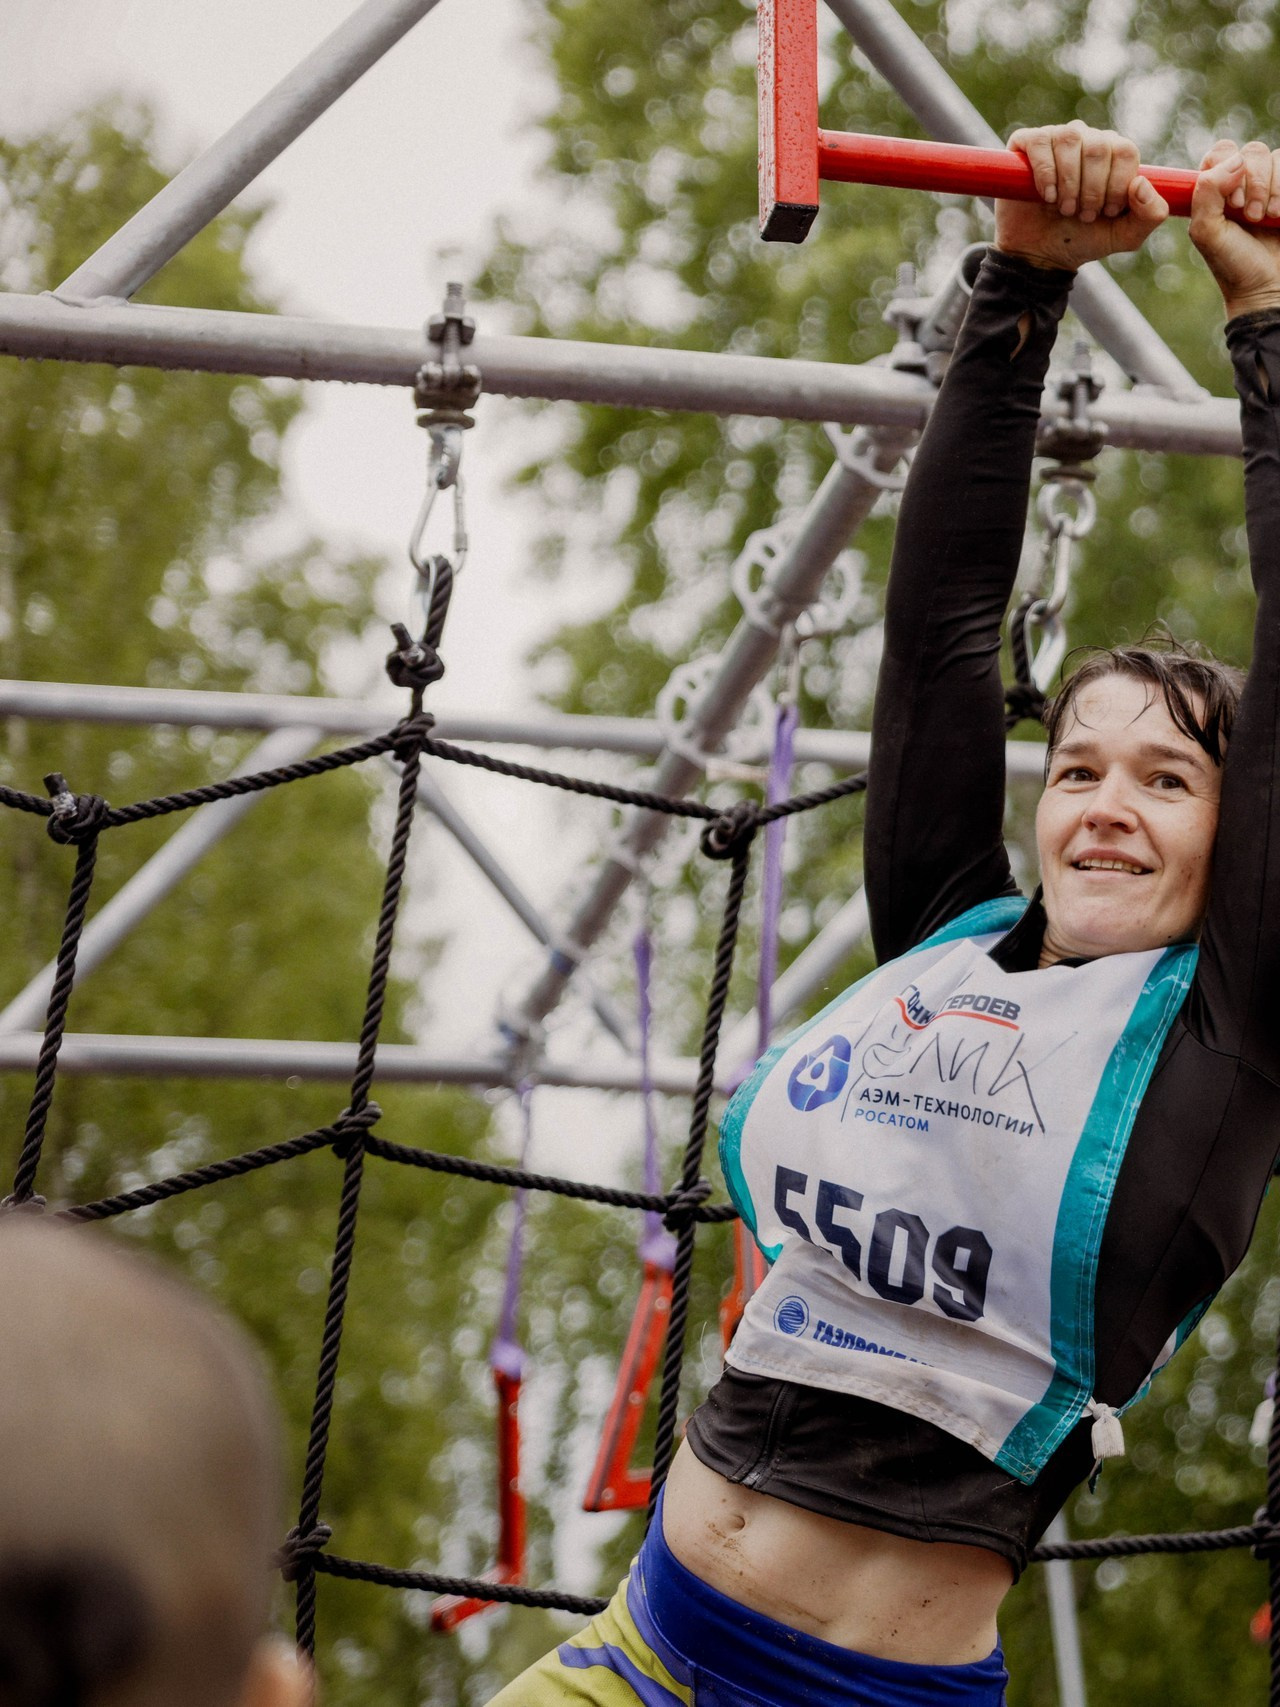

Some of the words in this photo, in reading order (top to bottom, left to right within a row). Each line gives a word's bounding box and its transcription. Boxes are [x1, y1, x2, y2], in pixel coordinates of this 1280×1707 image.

[940, 994, 1021, 1020] ГЕРОЕВ
[855, 1108, 929, 1132] РОСАТОМ
[859, 1087, 1034, 1137] АЭМ-ТЕХНОЛОГИИ
[774, 1165, 993, 1322] 5509
